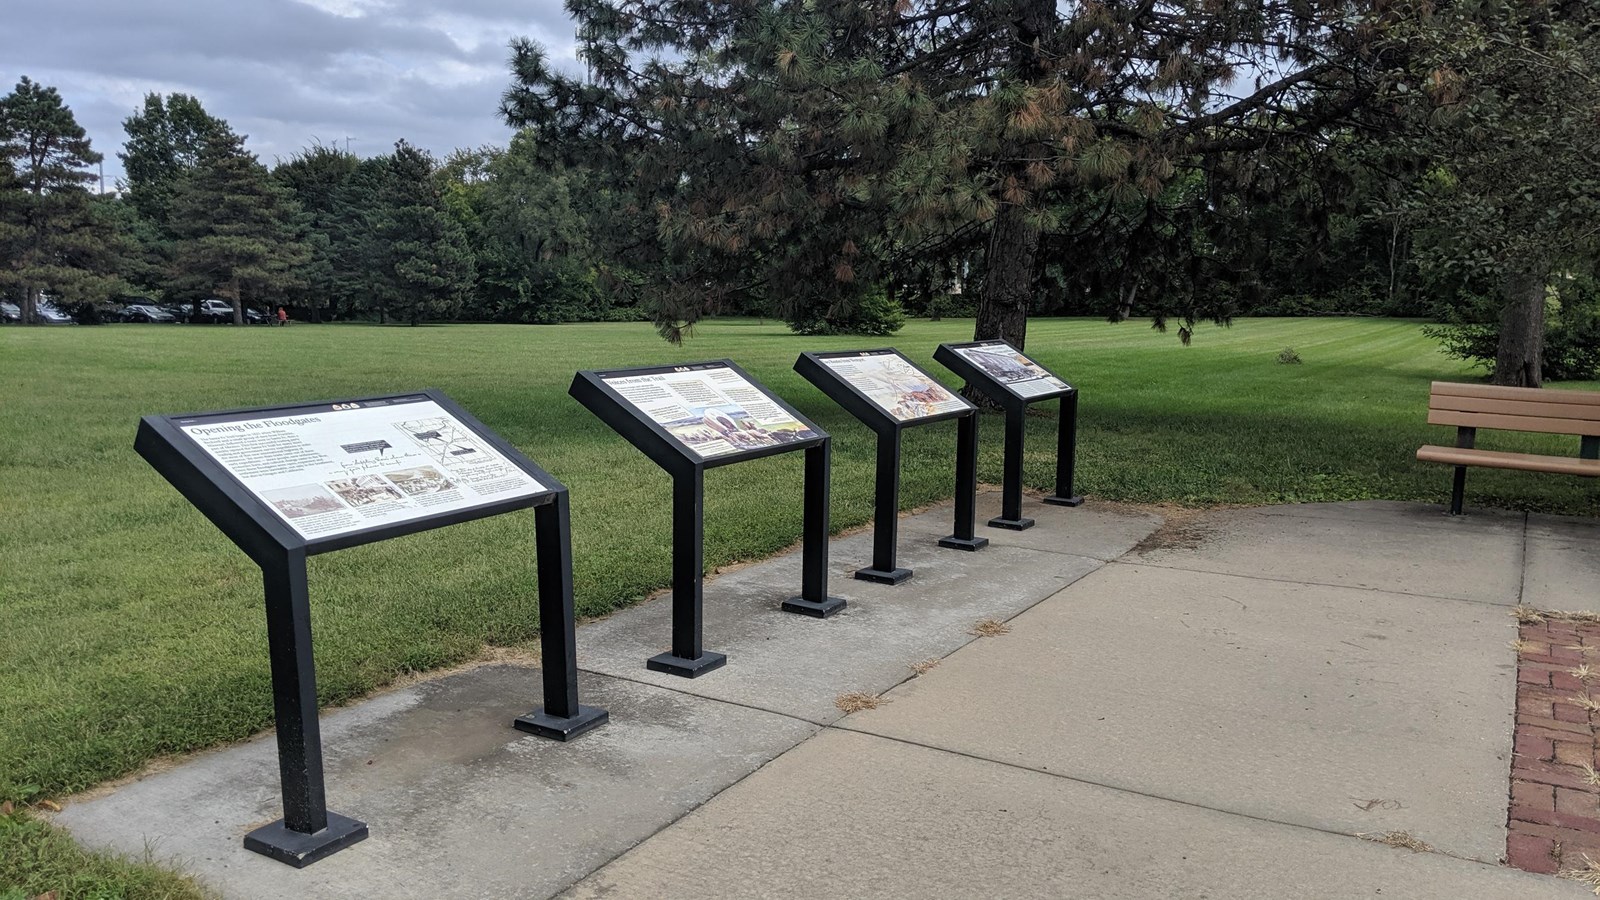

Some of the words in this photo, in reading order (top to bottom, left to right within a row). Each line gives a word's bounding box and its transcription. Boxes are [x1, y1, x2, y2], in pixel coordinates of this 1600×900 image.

[190, 425, 245, 436] Opening
[244, 422, 264, 430] the
[264, 416, 321, 427] Floodgates
